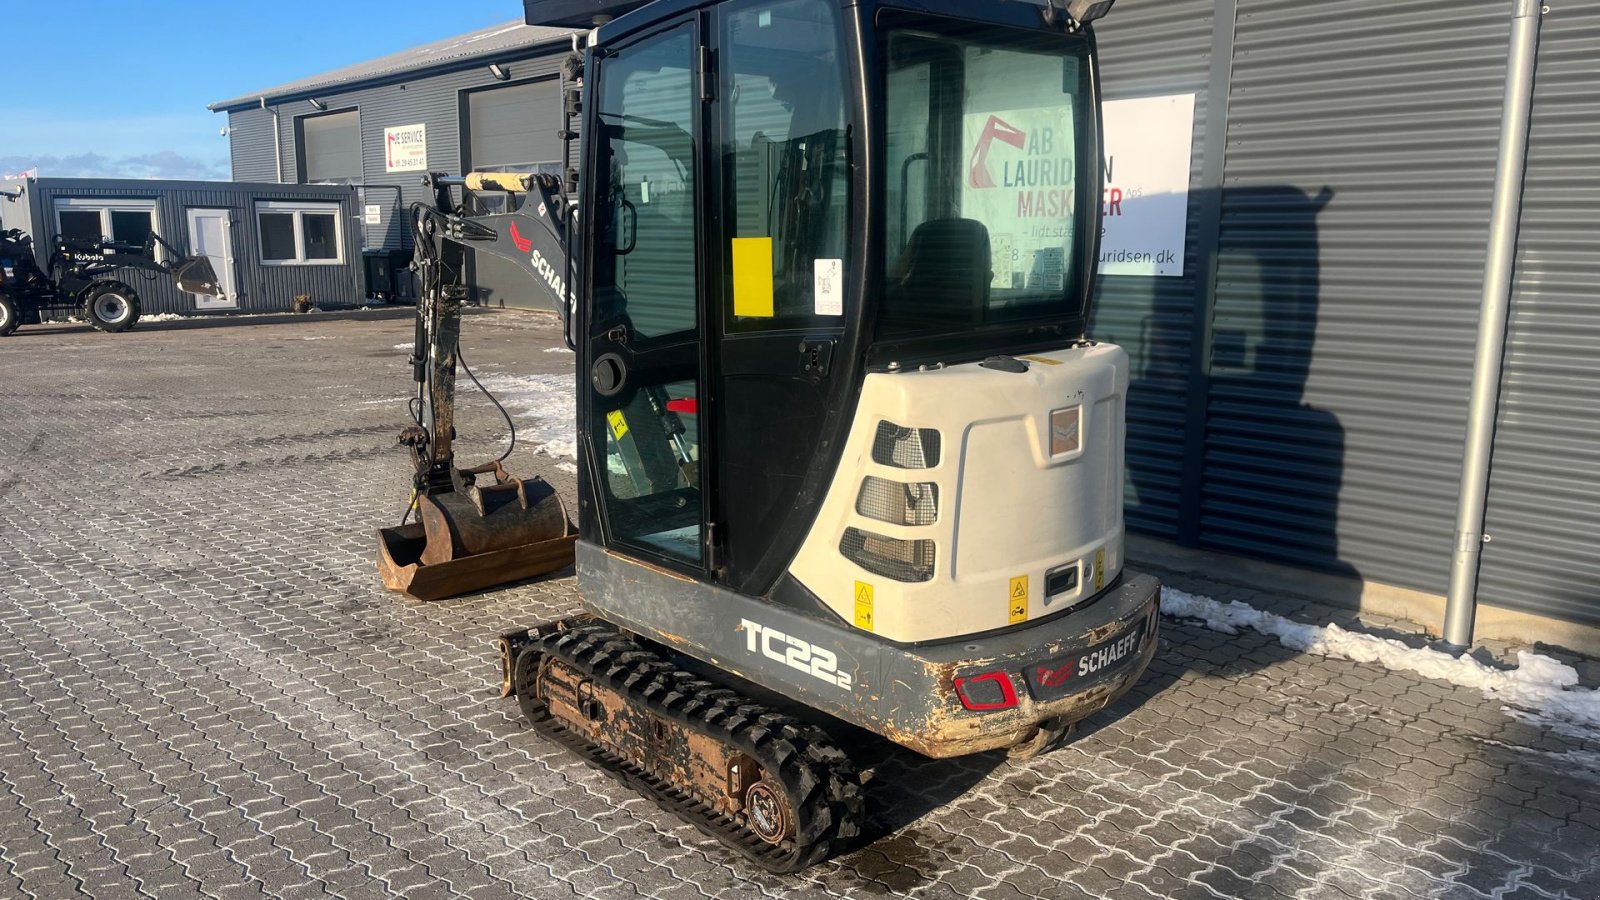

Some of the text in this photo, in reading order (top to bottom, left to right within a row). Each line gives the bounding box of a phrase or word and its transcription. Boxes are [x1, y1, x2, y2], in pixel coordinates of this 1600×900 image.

[401, 130, 423, 144] SERVICE
[1028, 127, 1054, 156] AB
[1003, 155, 1114, 188] LAURIDN
[1126, 187, 1143, 198] ApS
[74, 253, 104, 261] Kubota
[1099, 249, 1175, 264] uridsen.dk
[1078, 630, 1137, 678] SCHAEFF
